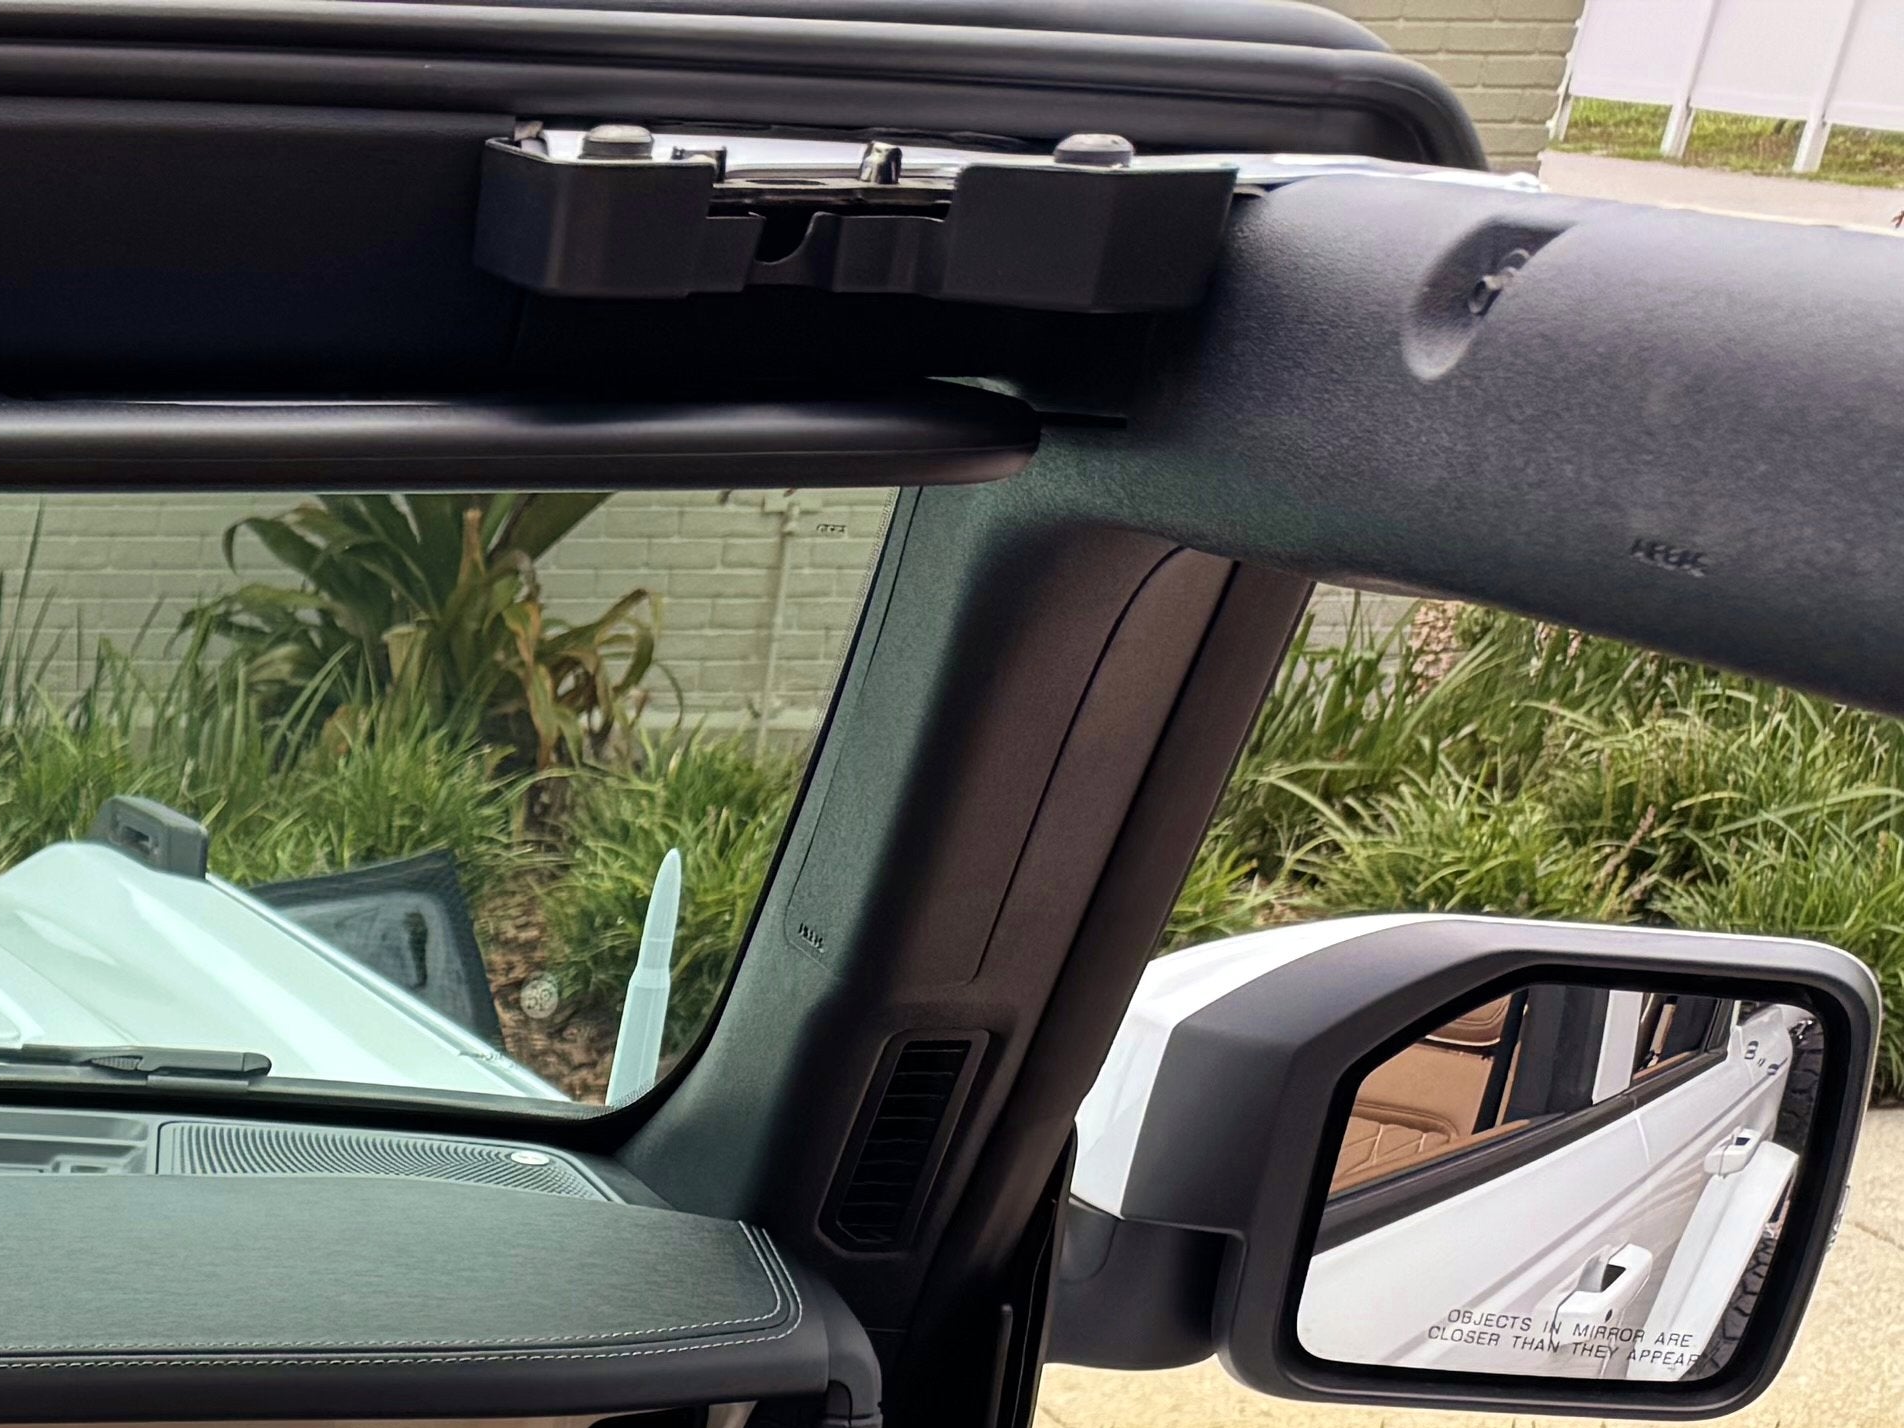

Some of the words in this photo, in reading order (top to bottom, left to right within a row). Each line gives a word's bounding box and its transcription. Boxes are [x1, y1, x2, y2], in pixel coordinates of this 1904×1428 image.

[1428, 1325, 1500, 1346] CLOSER
[1512, 1335, 1560, 1353] THAN
[1572, 1342, 1619, 1360] THEY
[1447, 1309, 1532, 1331] OBJECTS
[1544, 1322, 1562, 1335] IN
[1573, 1323, 1645, 1343] MIRROR
[1655, 1332, 1693, 1348] ARE
